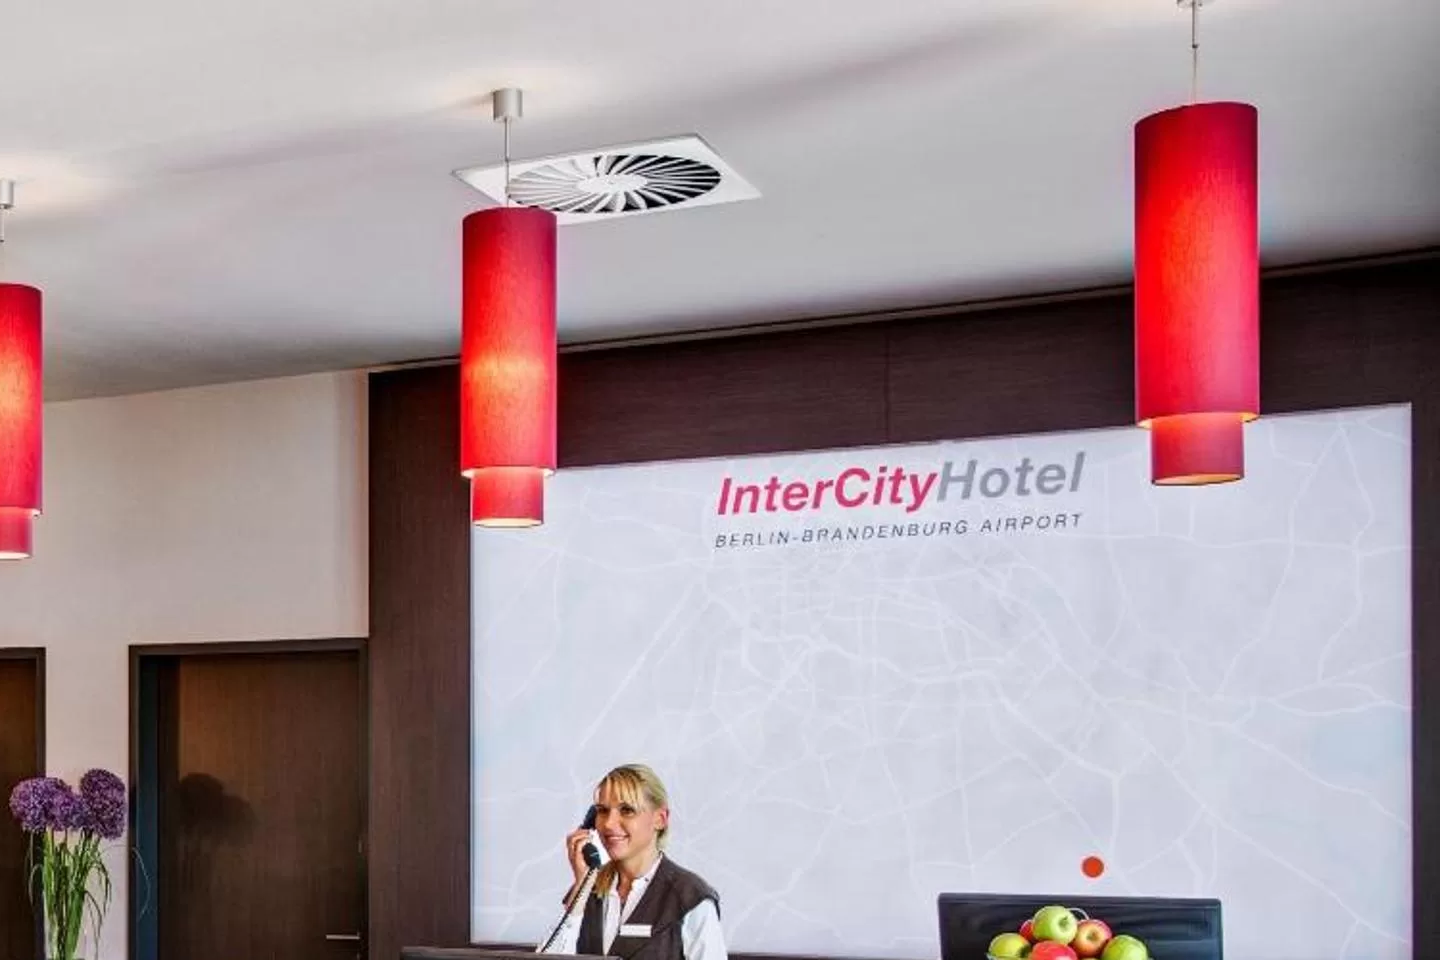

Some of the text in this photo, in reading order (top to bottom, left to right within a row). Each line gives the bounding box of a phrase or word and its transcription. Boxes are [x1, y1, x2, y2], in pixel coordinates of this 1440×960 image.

[717, 451, 1085, 515] InterCityHotel
[715, 512, 1084, 549] BERLIN-BRANDENBURG AIRPORT
